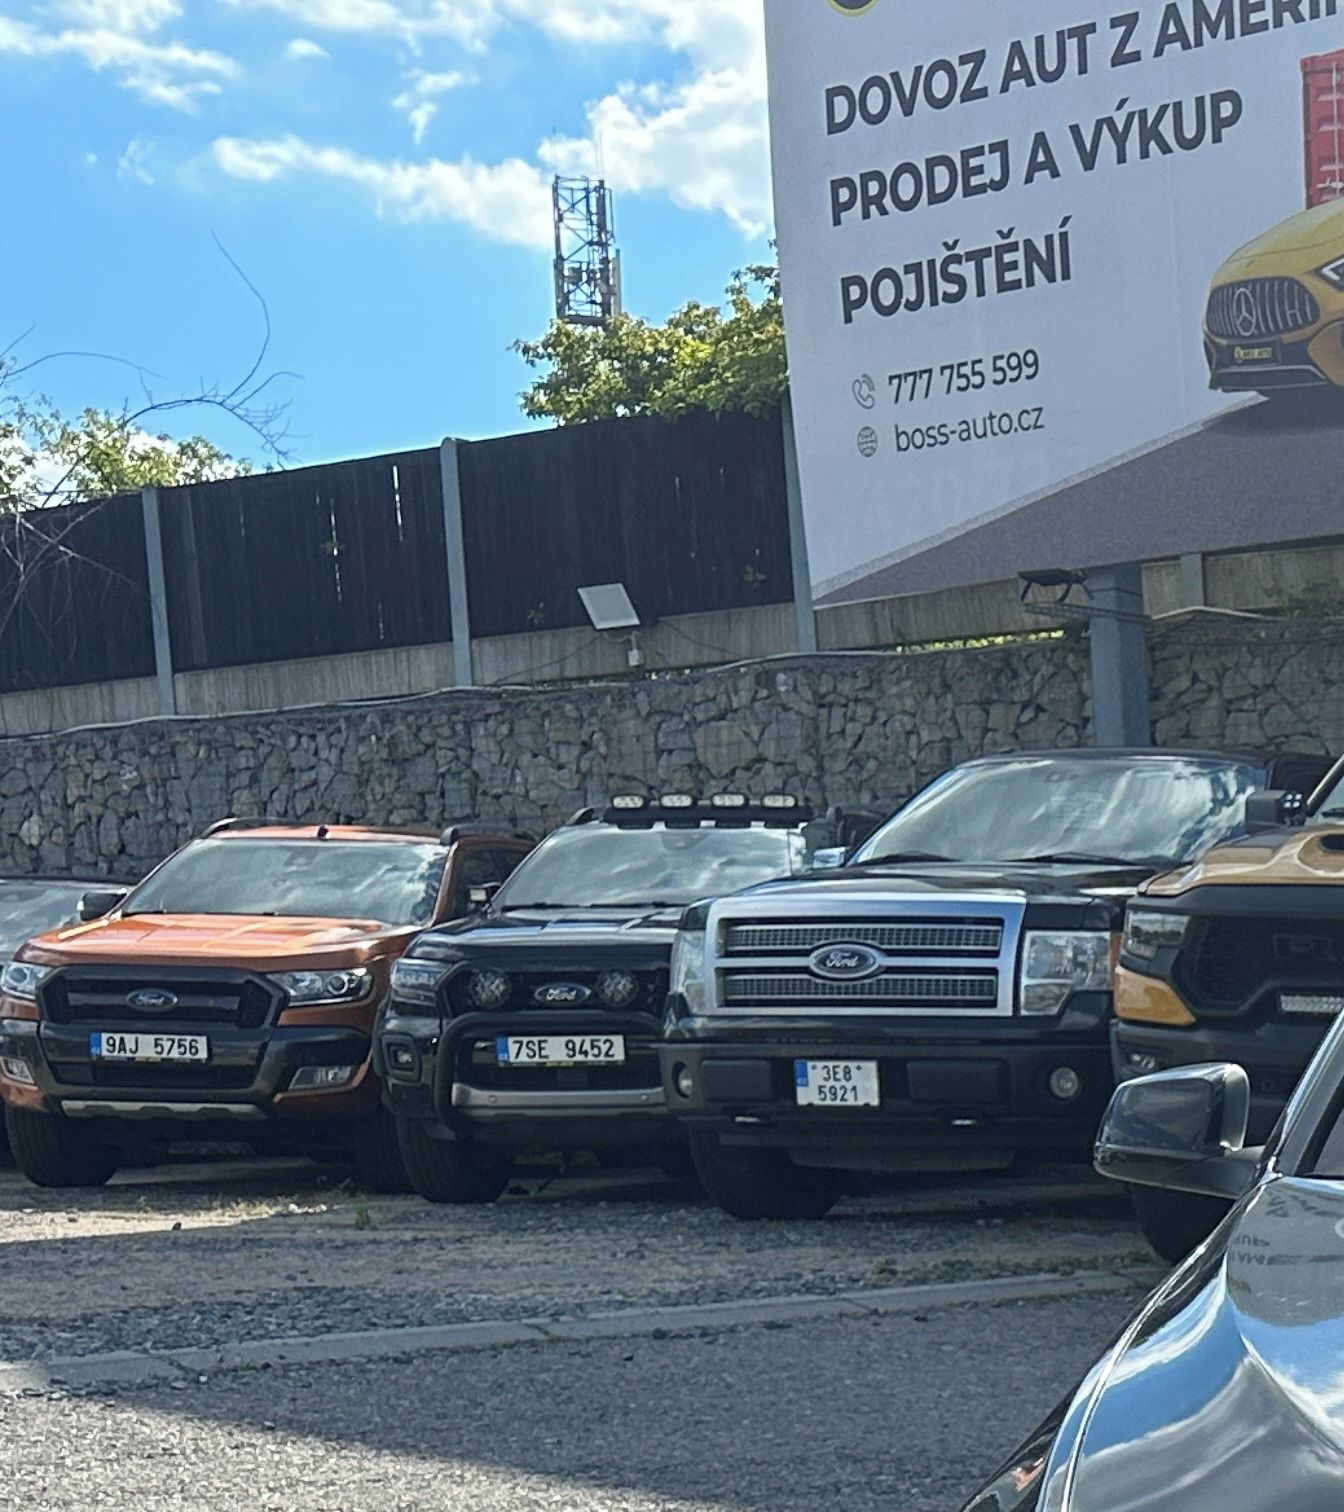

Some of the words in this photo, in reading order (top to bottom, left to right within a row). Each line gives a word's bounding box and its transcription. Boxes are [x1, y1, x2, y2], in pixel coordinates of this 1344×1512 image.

[824, 49, 989, 136] DOVOZ
[999, 22, 1097, 95] AUT
[1109, 11, 1142, 68] Z
[829, 139, 1010, 227] PRODEJ
[1024, 131, 1061, 185] A
[1069, 89, 1244, 173] VÝKUP
[840, 215, 1073, 325] POJIŠTĚNÍ
[888, 368, 934, 405] 777
[940, 358, 986, 396] 755
[992, 349, 1039, 386] 599
[894, 406, 1046, 453] boss-auto.cz
[825, 951, 859, 968] Ford
[105, 1036, 139, 1055] 9AJ
[153, 1038, 200, 1057] 5756
[512, 1039, 550, 1060] 7SE
[564, 1038, 615, 1059] 9452
[821, 1064, 853, 1082] 3E8
[818, 1084, 859, 1102] 5921
